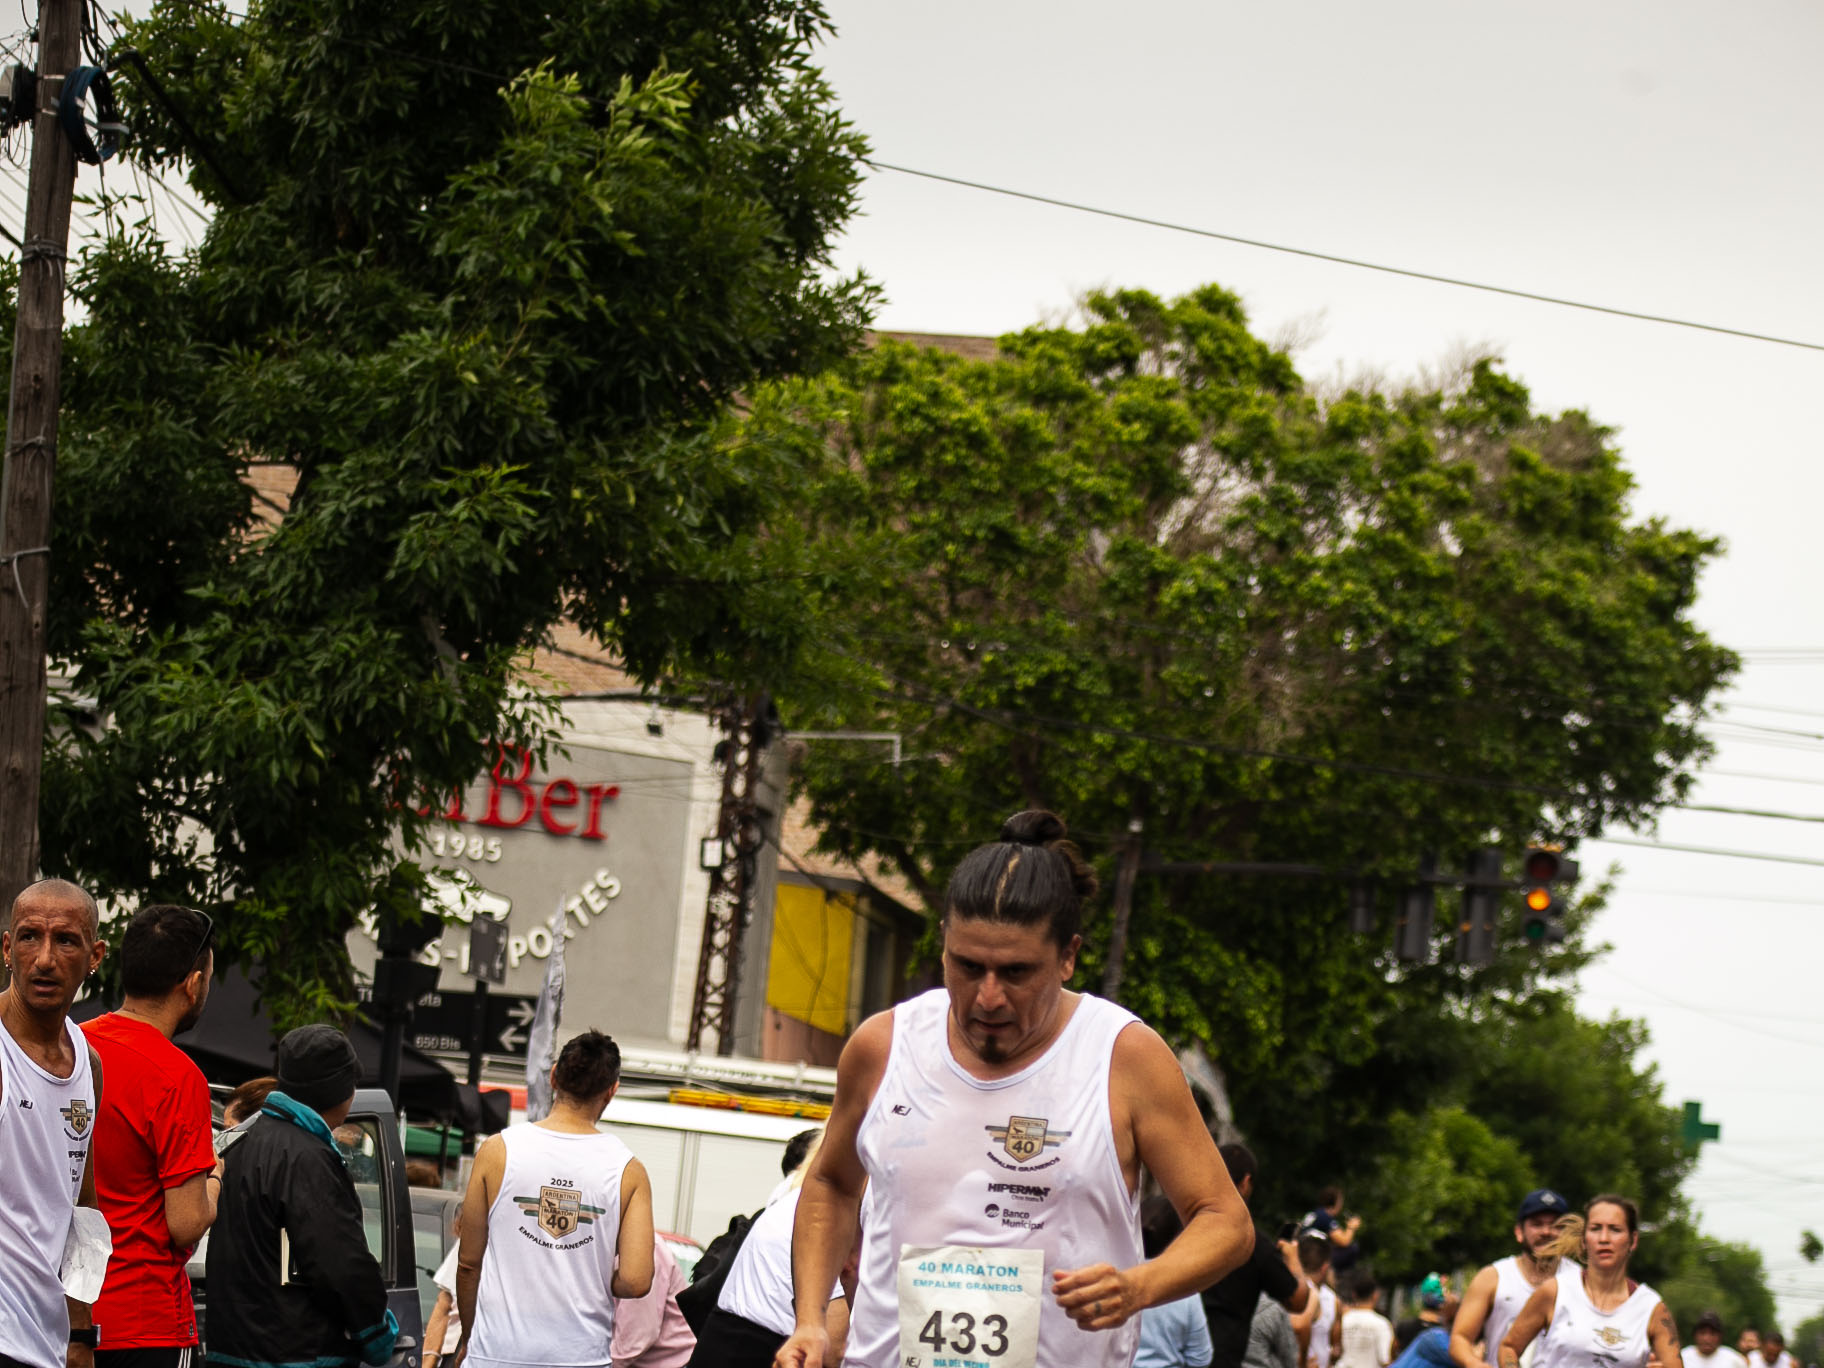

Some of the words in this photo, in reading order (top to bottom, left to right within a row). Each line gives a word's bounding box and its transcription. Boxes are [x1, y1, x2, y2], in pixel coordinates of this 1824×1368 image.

[432, 832, 503, 863] 1985
[1012, 1141, 1035, 1154] 40
[986, 1151, 1017, 1171] EMPALME
[1017, 1156, 1061, 1172] GRANEROS
[551, 1178, 574, 1187] 2025
[1002, 1208, 1030, 1219] Banco
[546, 1214, 569, 1231] 40
[1001, 1218, 1045, 1231] Municipal
[518, 1226, 554, 1249] EMPALME
[555, 1235, 594, 1250] GRANEROS
[918, 1261, 936, 1273] 40
[941, 1263, 1019, 1278] MARATON
[912, 1278, 963, 1289] EMPALME
[965, 1283, 1023, 1293] GRANEROS
[918, 1310, 1009, 1357] 433
